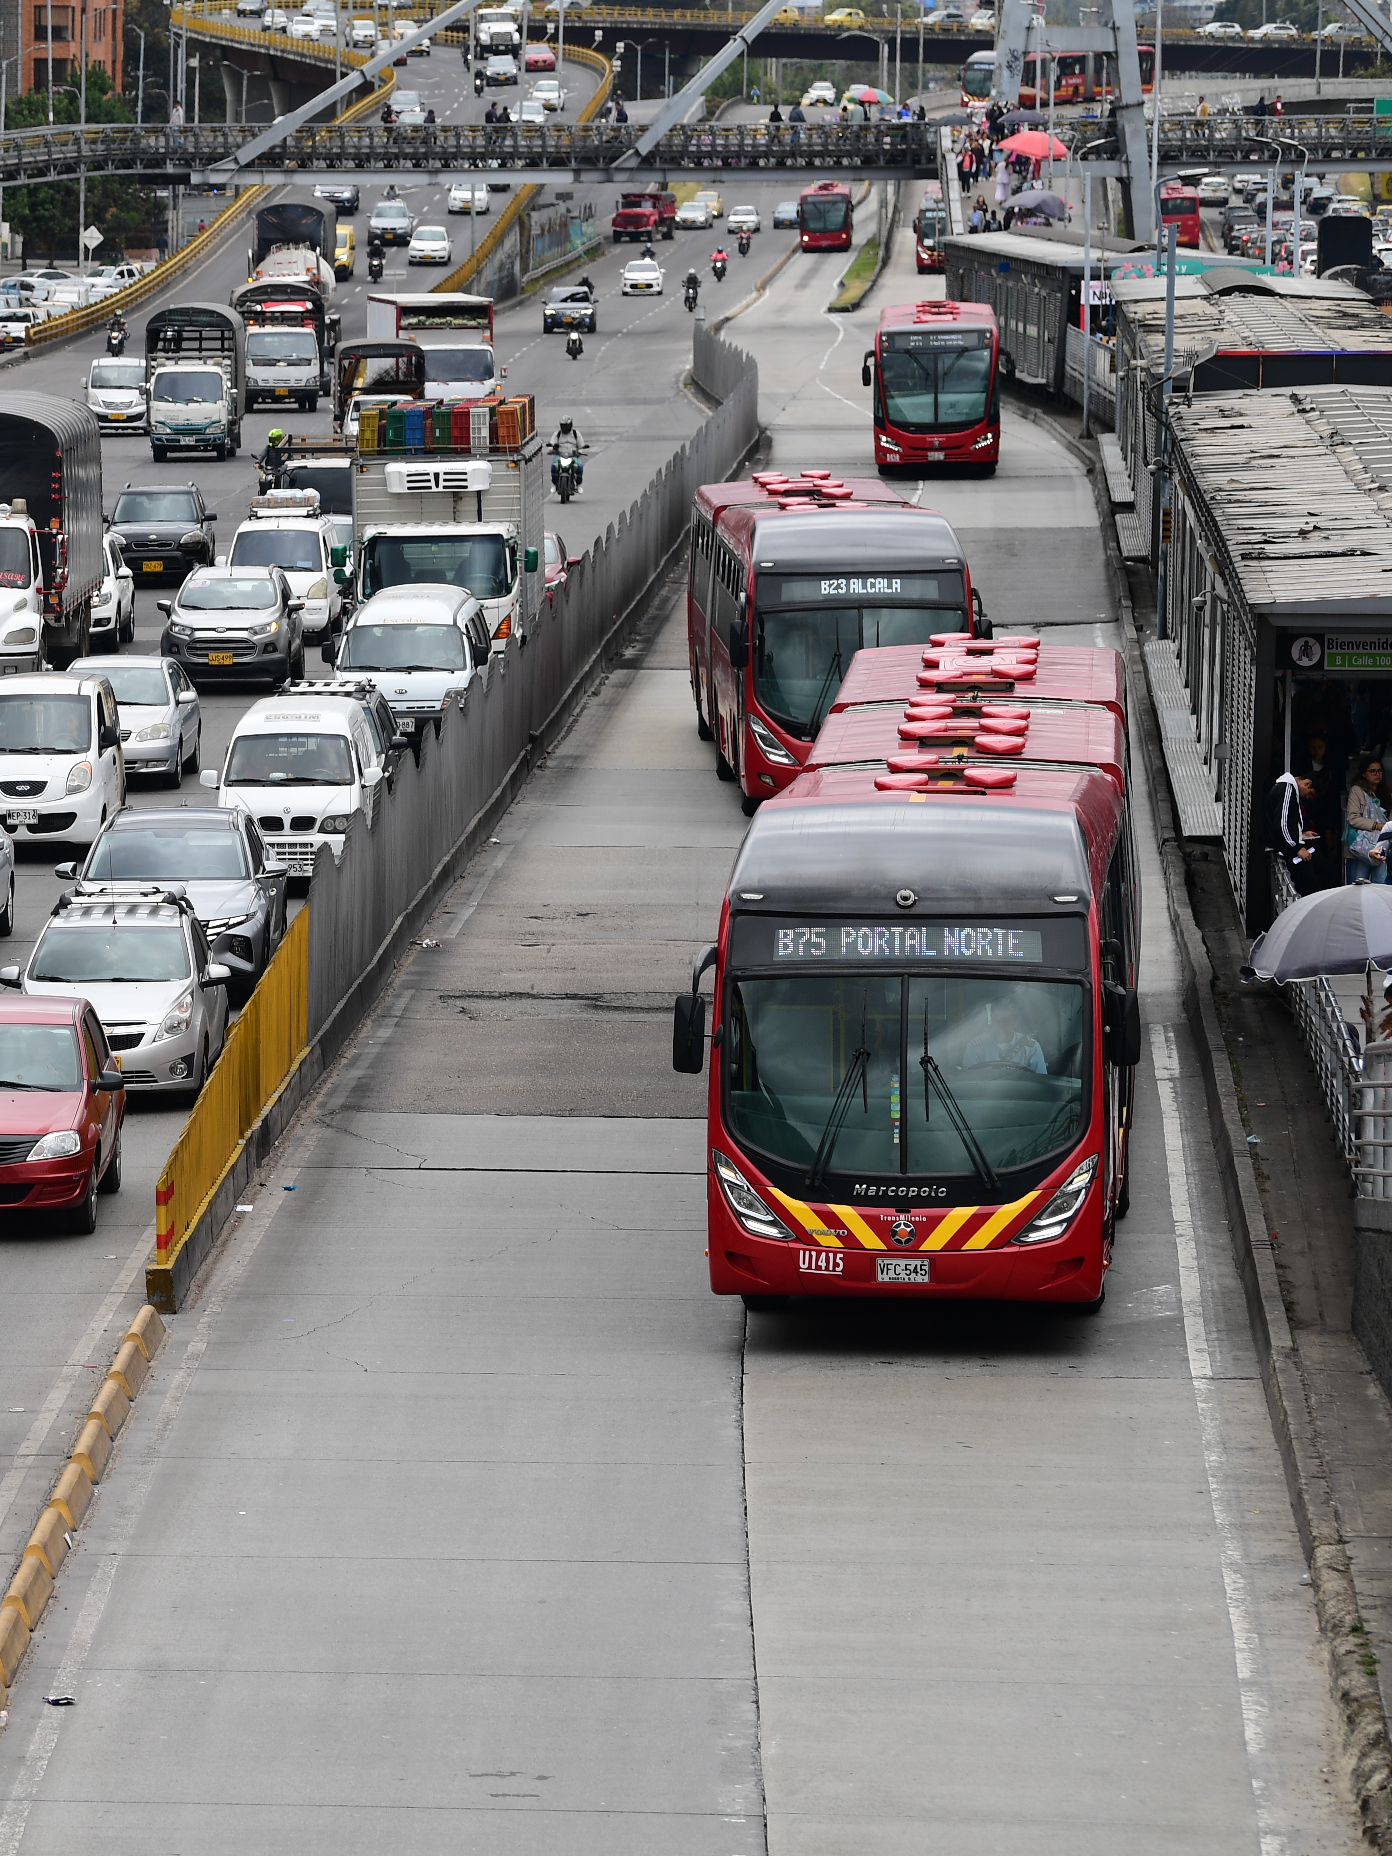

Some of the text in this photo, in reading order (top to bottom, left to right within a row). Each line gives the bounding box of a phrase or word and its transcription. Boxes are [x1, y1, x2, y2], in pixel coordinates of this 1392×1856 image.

[821, 577, 901, 594] B23 ALCALA
[1335, 655, 1392, 665] B Calle 100
[778, 926, 1023, 957] B75 PORTAL NORTE
[852, 1183, 947, 1198] Marcopolo
[879, 1214, 927, 1222] TransMilenio
[806, 1228, 848, 1237] VOLVO
[799, 1250, 844, 1273] U1415
